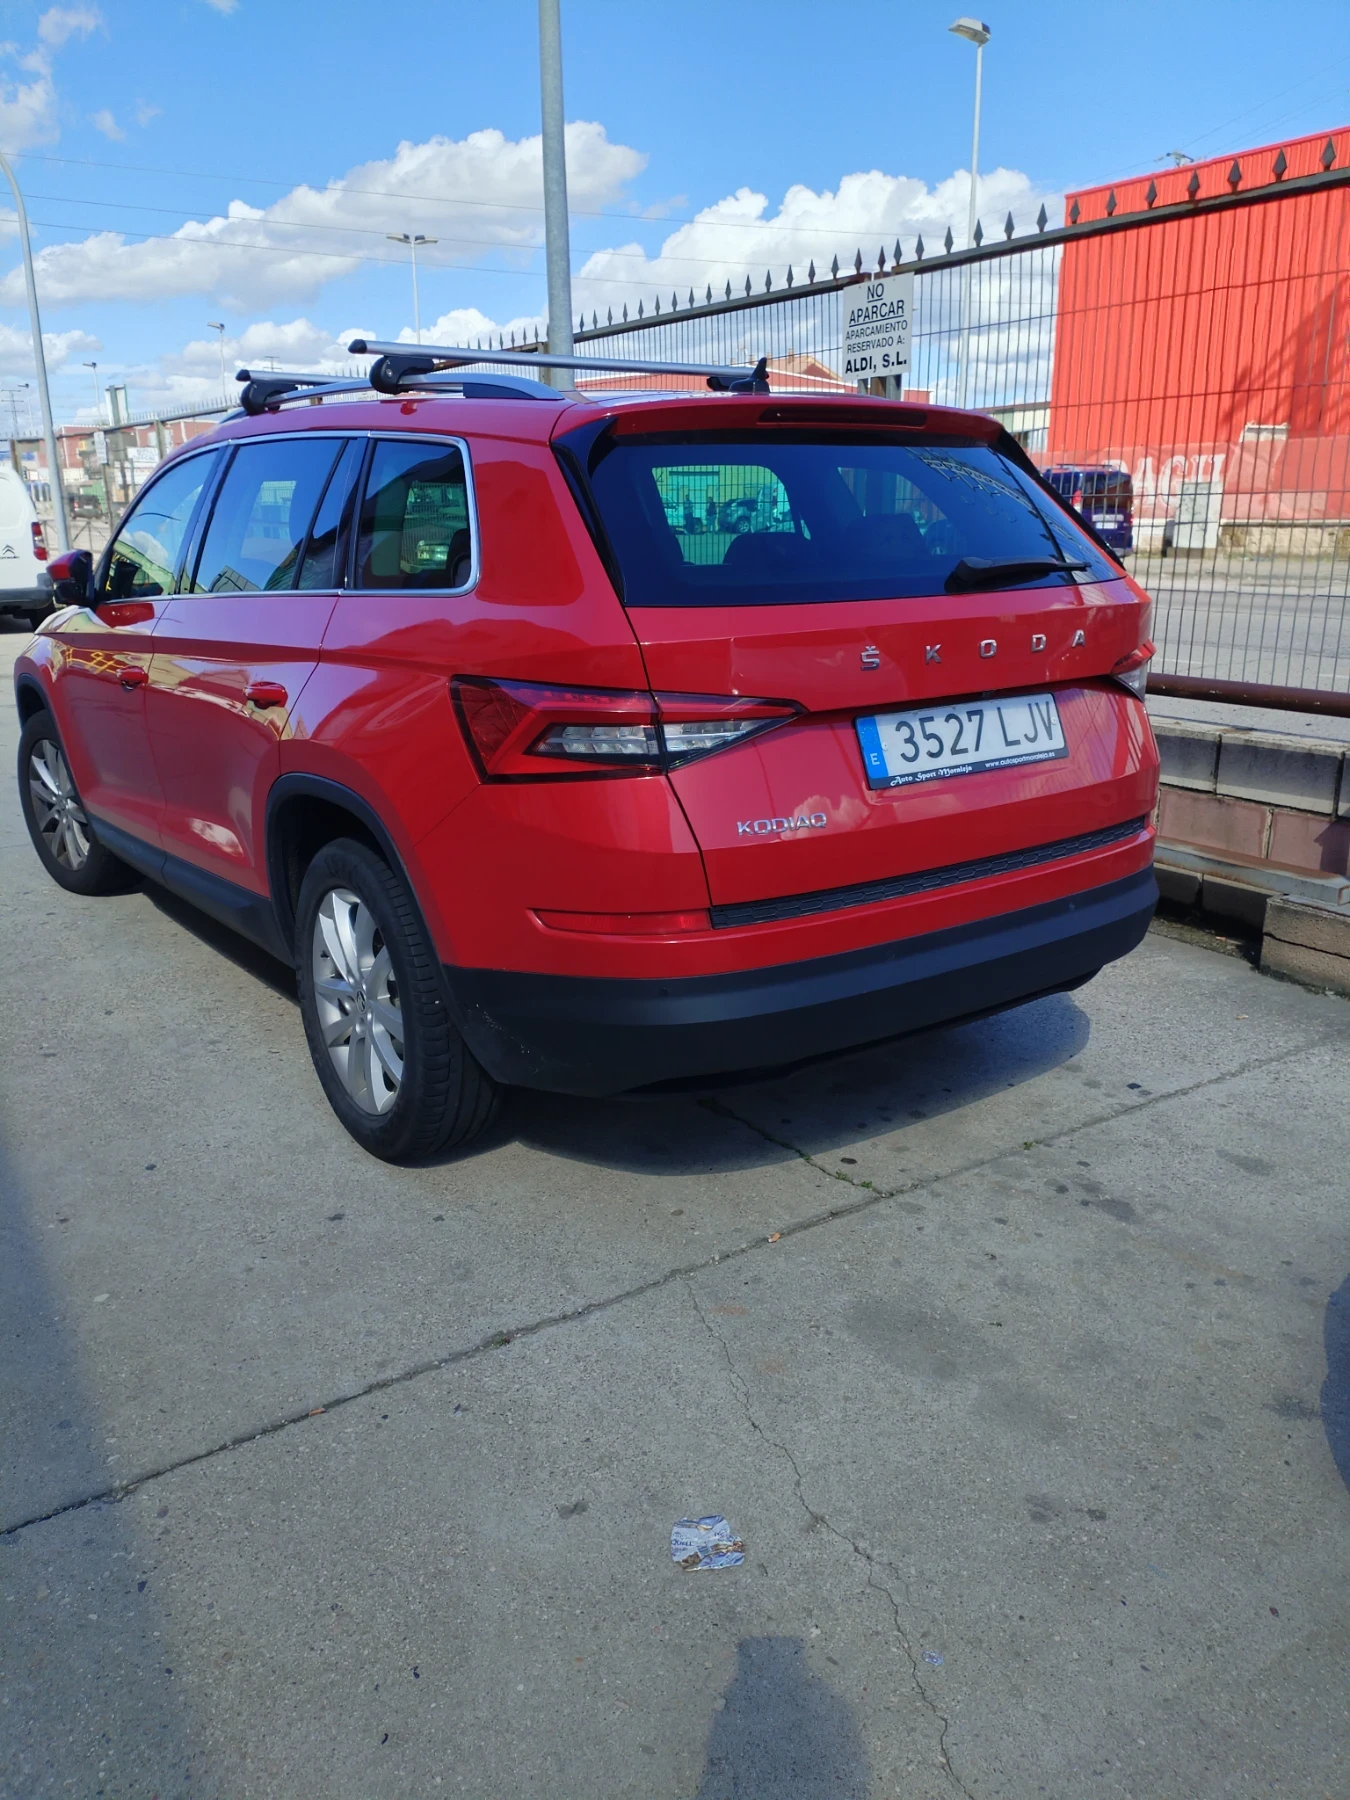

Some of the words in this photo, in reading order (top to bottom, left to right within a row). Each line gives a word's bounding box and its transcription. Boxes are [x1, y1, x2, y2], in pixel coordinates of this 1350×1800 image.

[866, 282, 885, 300] NO
[849, 299, 905, 325] APARCAR
[845, 319, 908, 341] APARCAMIENTO
[847, 336, 894, 354] RESERVADO
[896, 335, 905, 346] A:
[845, 356, 877, 374] ALDI,
[881, 351, 907, 368] S.L.
[895, 708, 985, 763] 3527
[997, 700, 1053, 747] LJV
[870, 752, 880, 766] E
[890, 776, 913, 787] Auto
[915, 772, 937, 781] Sport
[938, 764, 973, 777] Moraleja
[737, 812, 827, 836] KODIAQ
